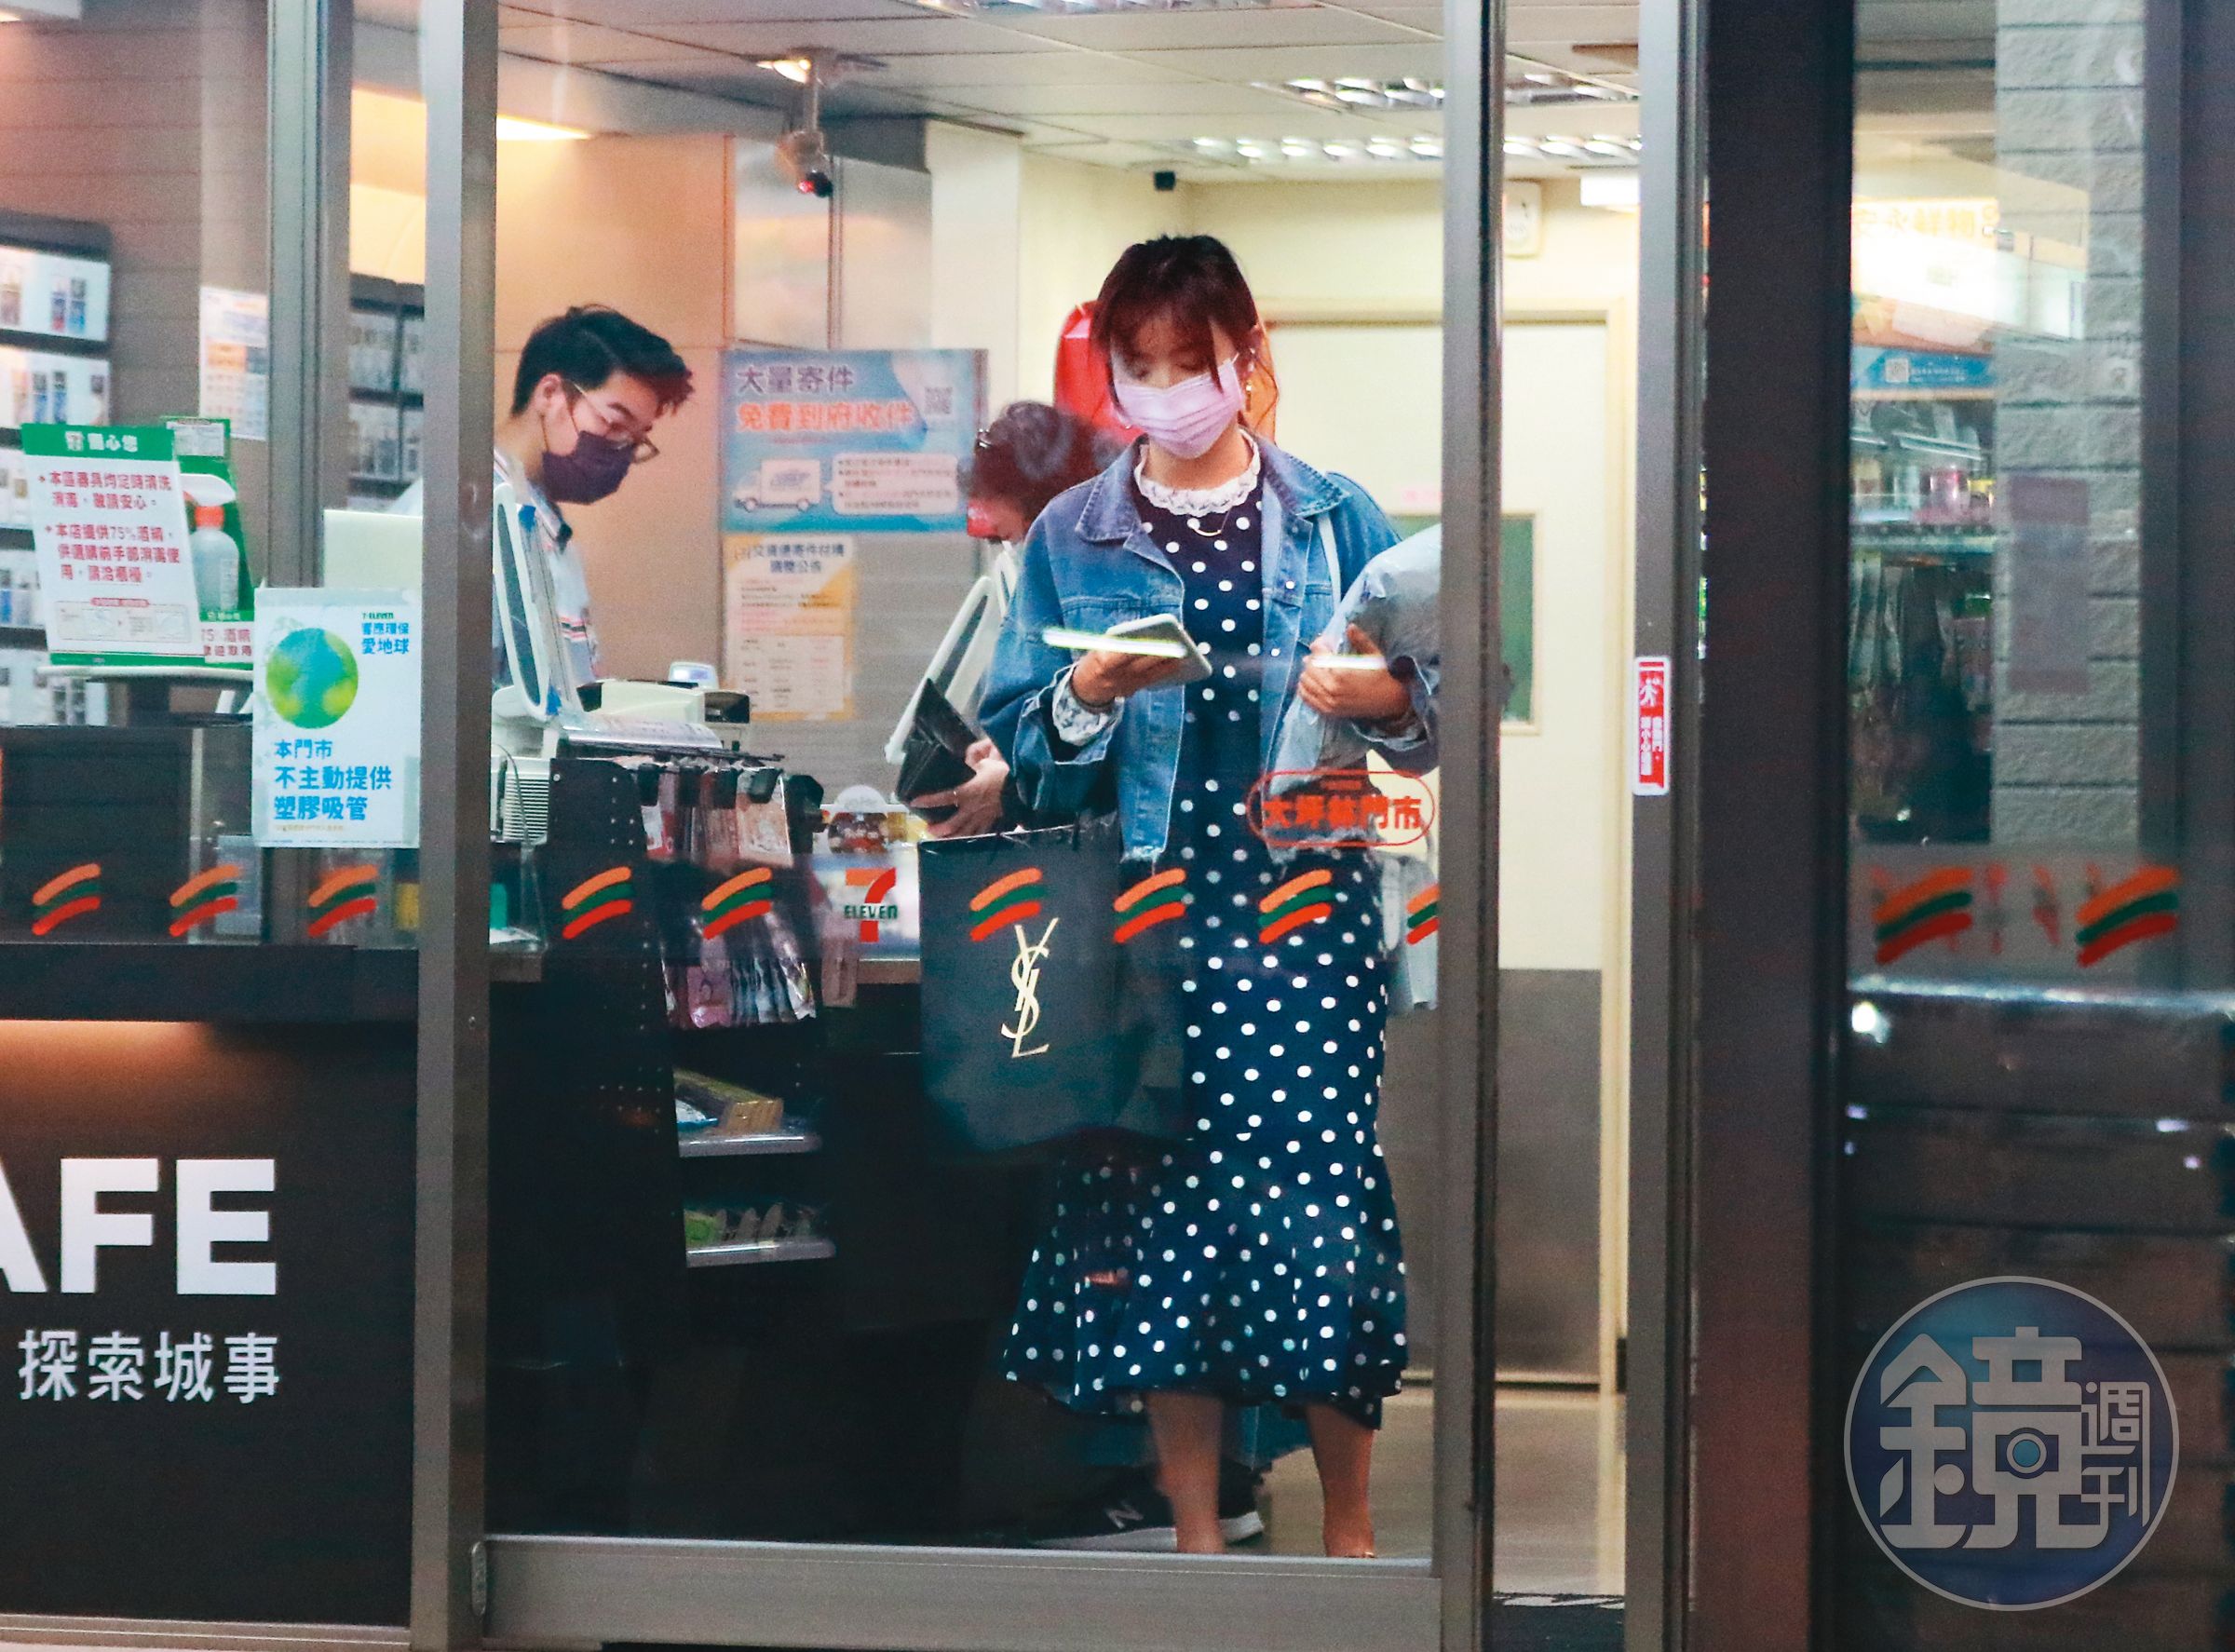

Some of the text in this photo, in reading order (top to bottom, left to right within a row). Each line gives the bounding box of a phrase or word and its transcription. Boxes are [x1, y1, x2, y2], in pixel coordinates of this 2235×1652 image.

[738, 364, 853, 395] 大量寄件
[361, 637, 410, 655] 愛地球
[274, 739, 332, 760] 本門市
[274, 765, 392, 791] 不主動提供
[274, 795, 368, 820] 塑膠吸管
[1000, 917, 1060, 1058] YSL
[19, 1329, 279, 1404] 探索城事
